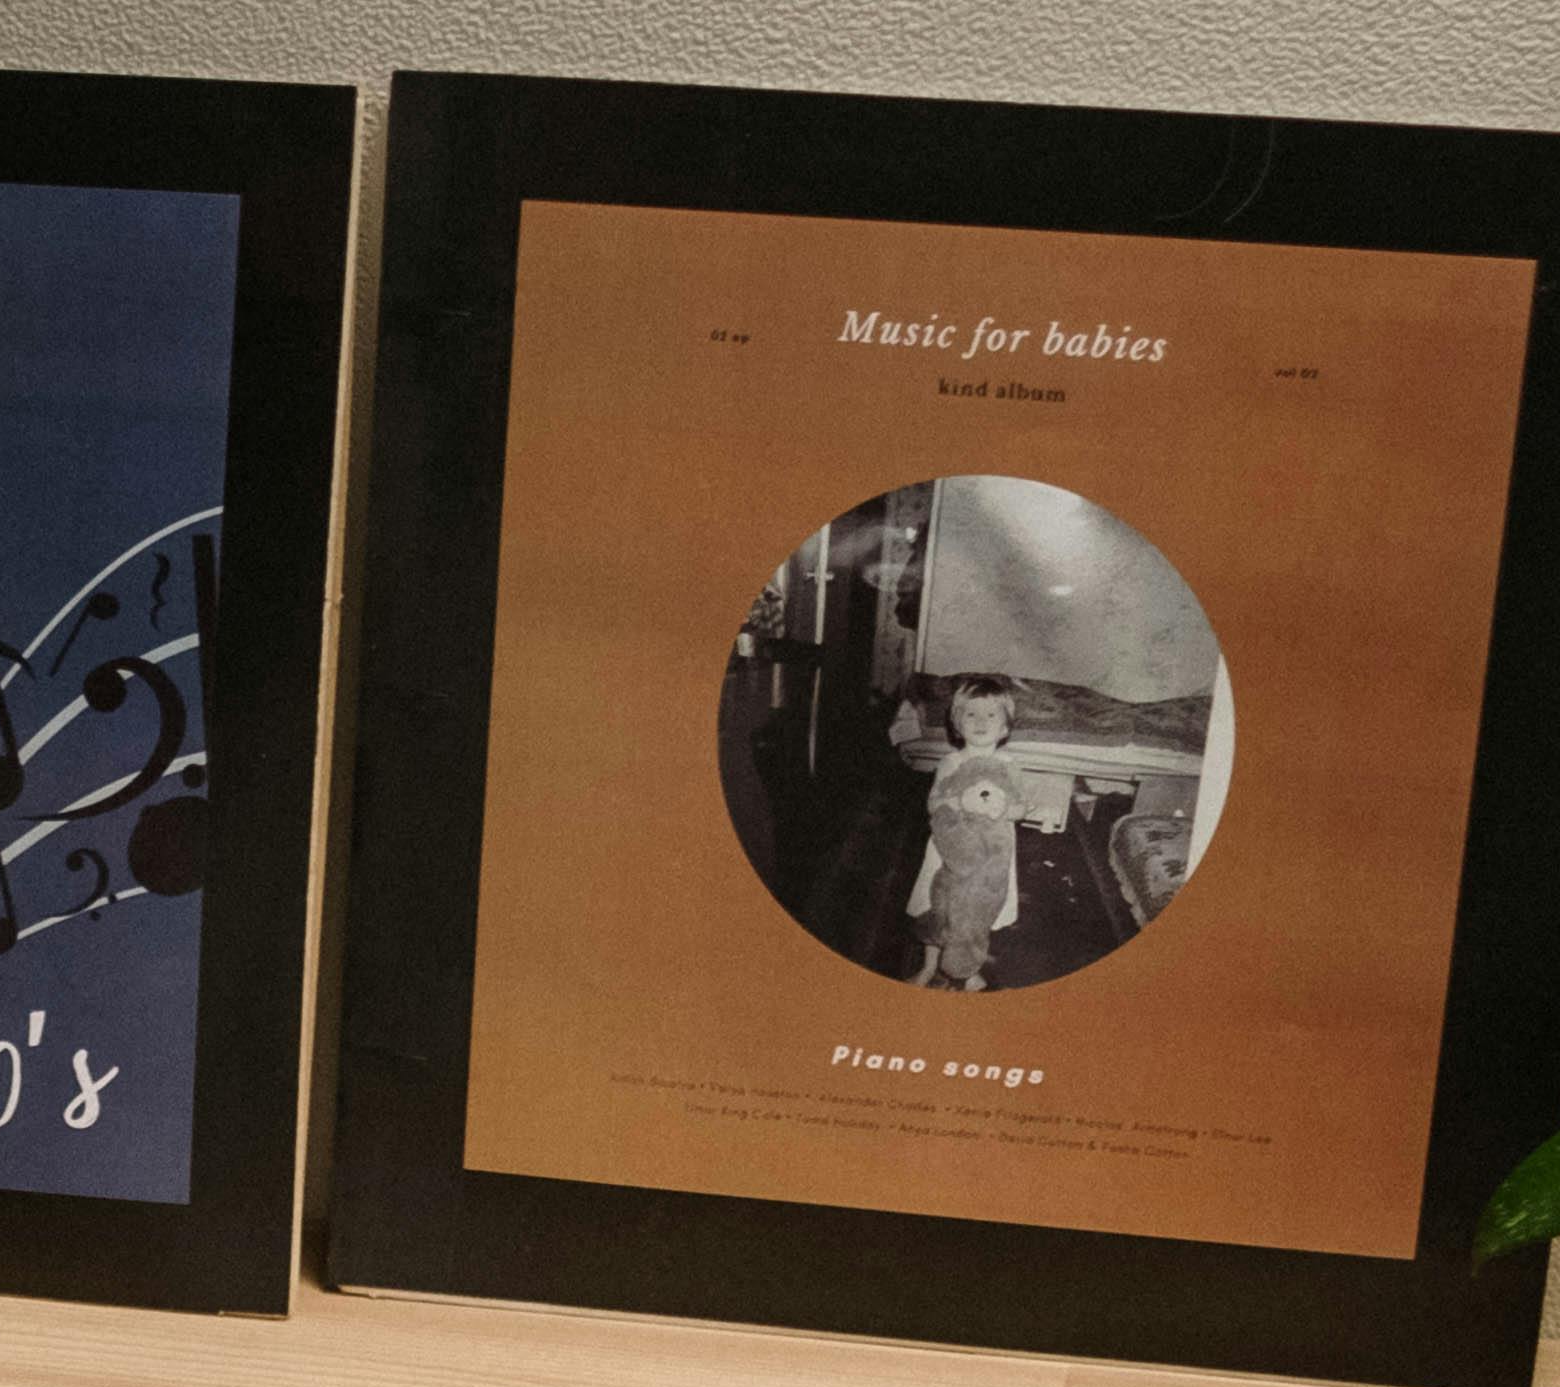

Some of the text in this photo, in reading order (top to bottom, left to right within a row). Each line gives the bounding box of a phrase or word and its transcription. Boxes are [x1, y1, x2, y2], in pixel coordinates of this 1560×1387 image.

[837, 309, 1167, 362] Music for babies
[937, 377, 1067, 404] kind album
[831, 1045, 1044, 1088] Piano songs
